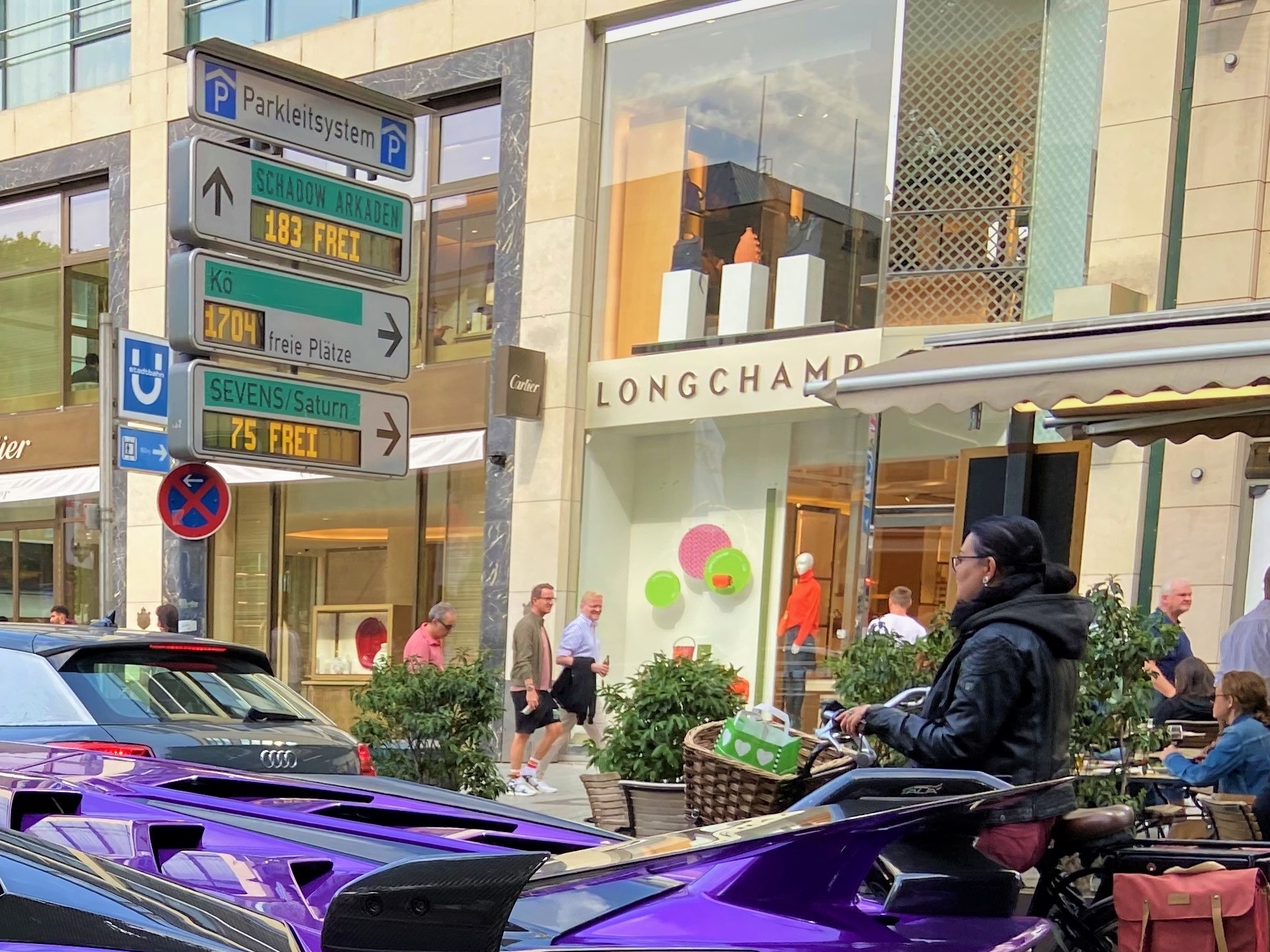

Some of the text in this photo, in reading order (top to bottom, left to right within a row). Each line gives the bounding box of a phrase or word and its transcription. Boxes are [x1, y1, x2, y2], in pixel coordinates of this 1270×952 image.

[243, 85, 375, 150] Parkleitsystem
[257, 167, 399, 229] SCHADOW ARKADEN
[265, 209, 360, 262] 183 FREI
[210, 267, 233, 294] Kö
[204, 304, 257, 345] 1704
[269, 331, 352, 364] freie Plätze
[129, 366, 165, 379] stadtbahn
[510, 373, 541, 393] Cartier
[597, 354, 864, 407] LONGCHAMP
[210, 377, 349, 420] SEVENS/Saturn
[231, 417, 318, 458] 75 FREI
